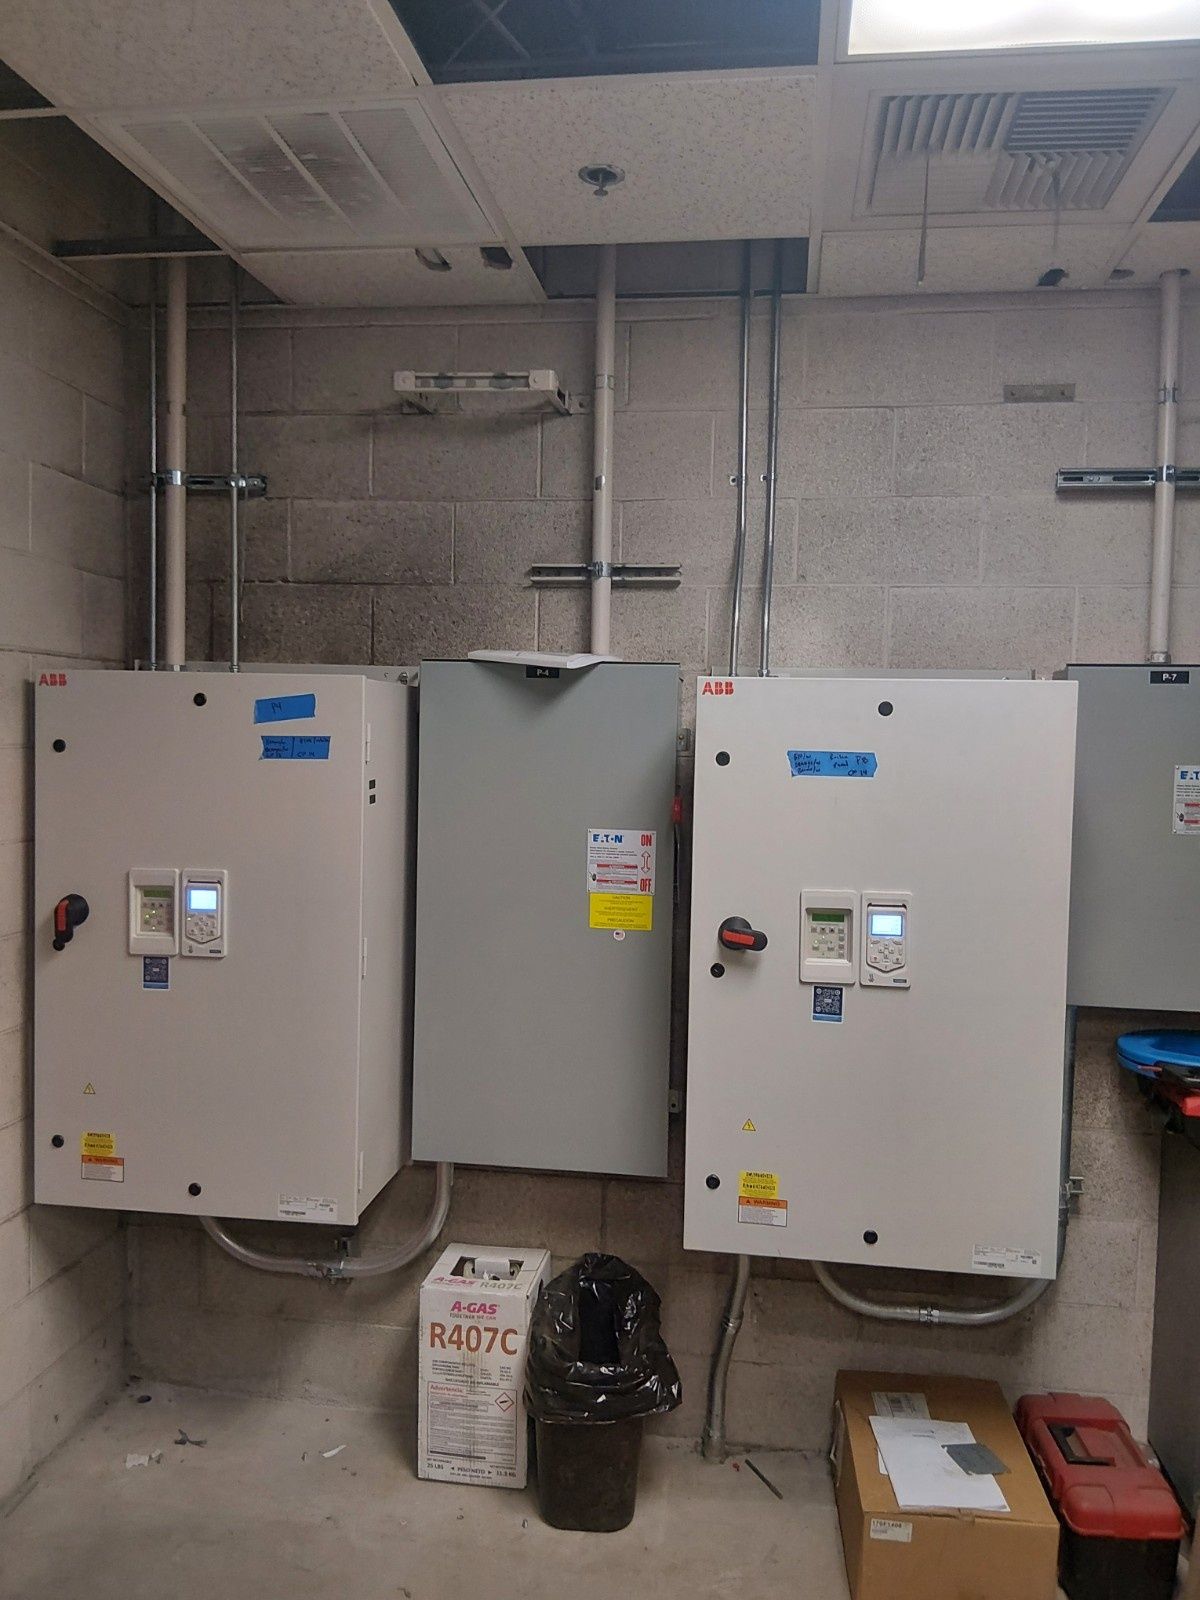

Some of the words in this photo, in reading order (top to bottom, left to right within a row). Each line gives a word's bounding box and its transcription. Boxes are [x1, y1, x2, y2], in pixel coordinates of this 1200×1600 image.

[536, 668, 550, 677] P-4
[1162, 673, 1178, 681] P-7
[38, 673, 68, 687] ABB
[701, 681, 734, 696] ABB
[640, 834, 653, 847] ON
[640, 878, 652, 893] OFF
[753, 1199, 780, 1207] WARNING
[480, 1281, 523, 1290] R407C
[450, 1300, 498, 1315] A-GAS
[429, 1321, 519, 1356] R407C
